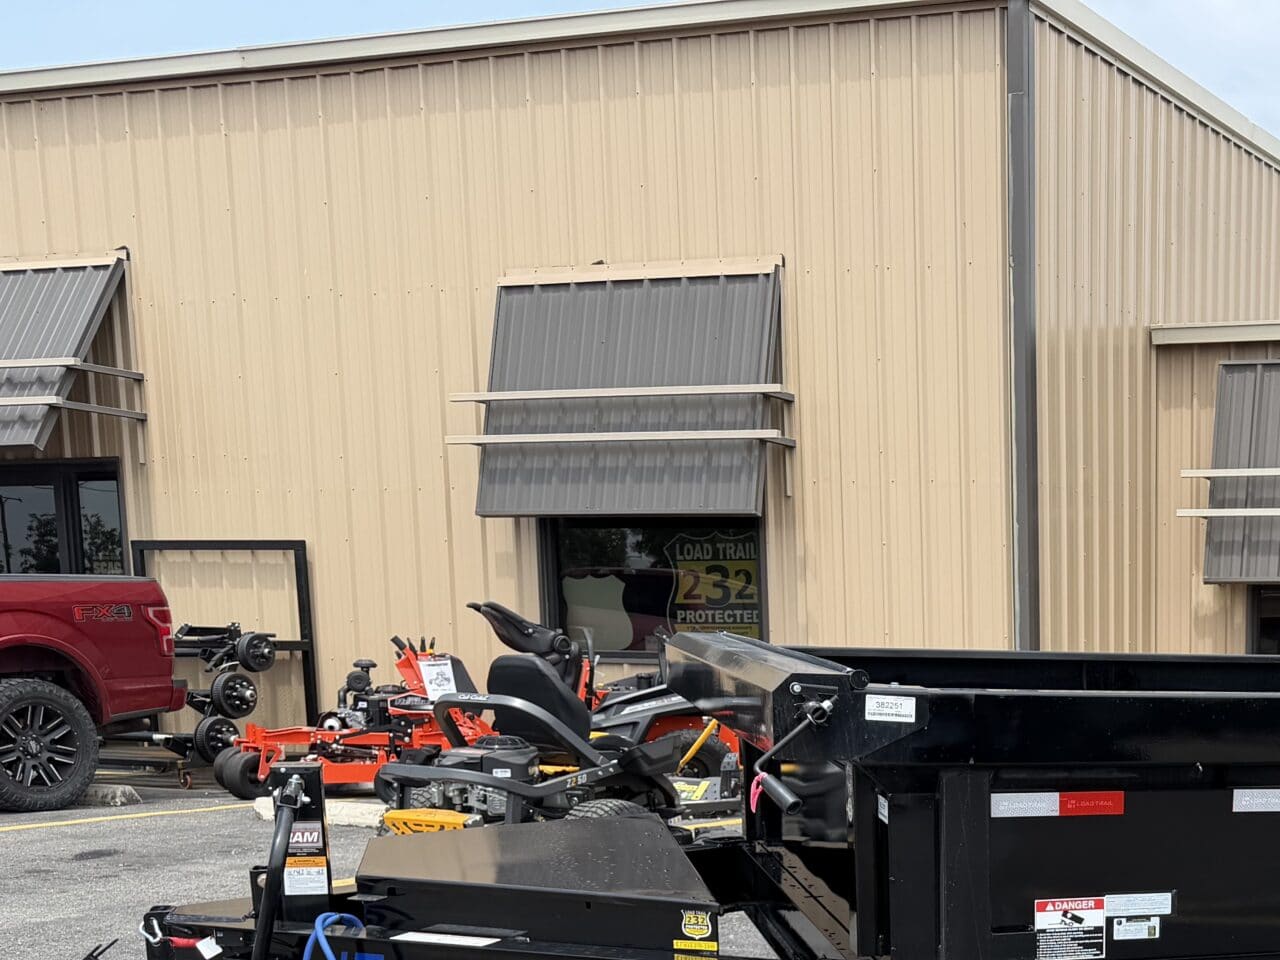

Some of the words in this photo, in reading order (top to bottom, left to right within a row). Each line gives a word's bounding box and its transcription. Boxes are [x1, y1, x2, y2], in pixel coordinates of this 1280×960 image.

[676, 543, 713, 561] LOAD
[683, 563, 755, 607] 232
[73, 604, 132, 622] FX4
[289, 831, 319, 843] AM
[1055, 900, 1095, 911] DANGER
